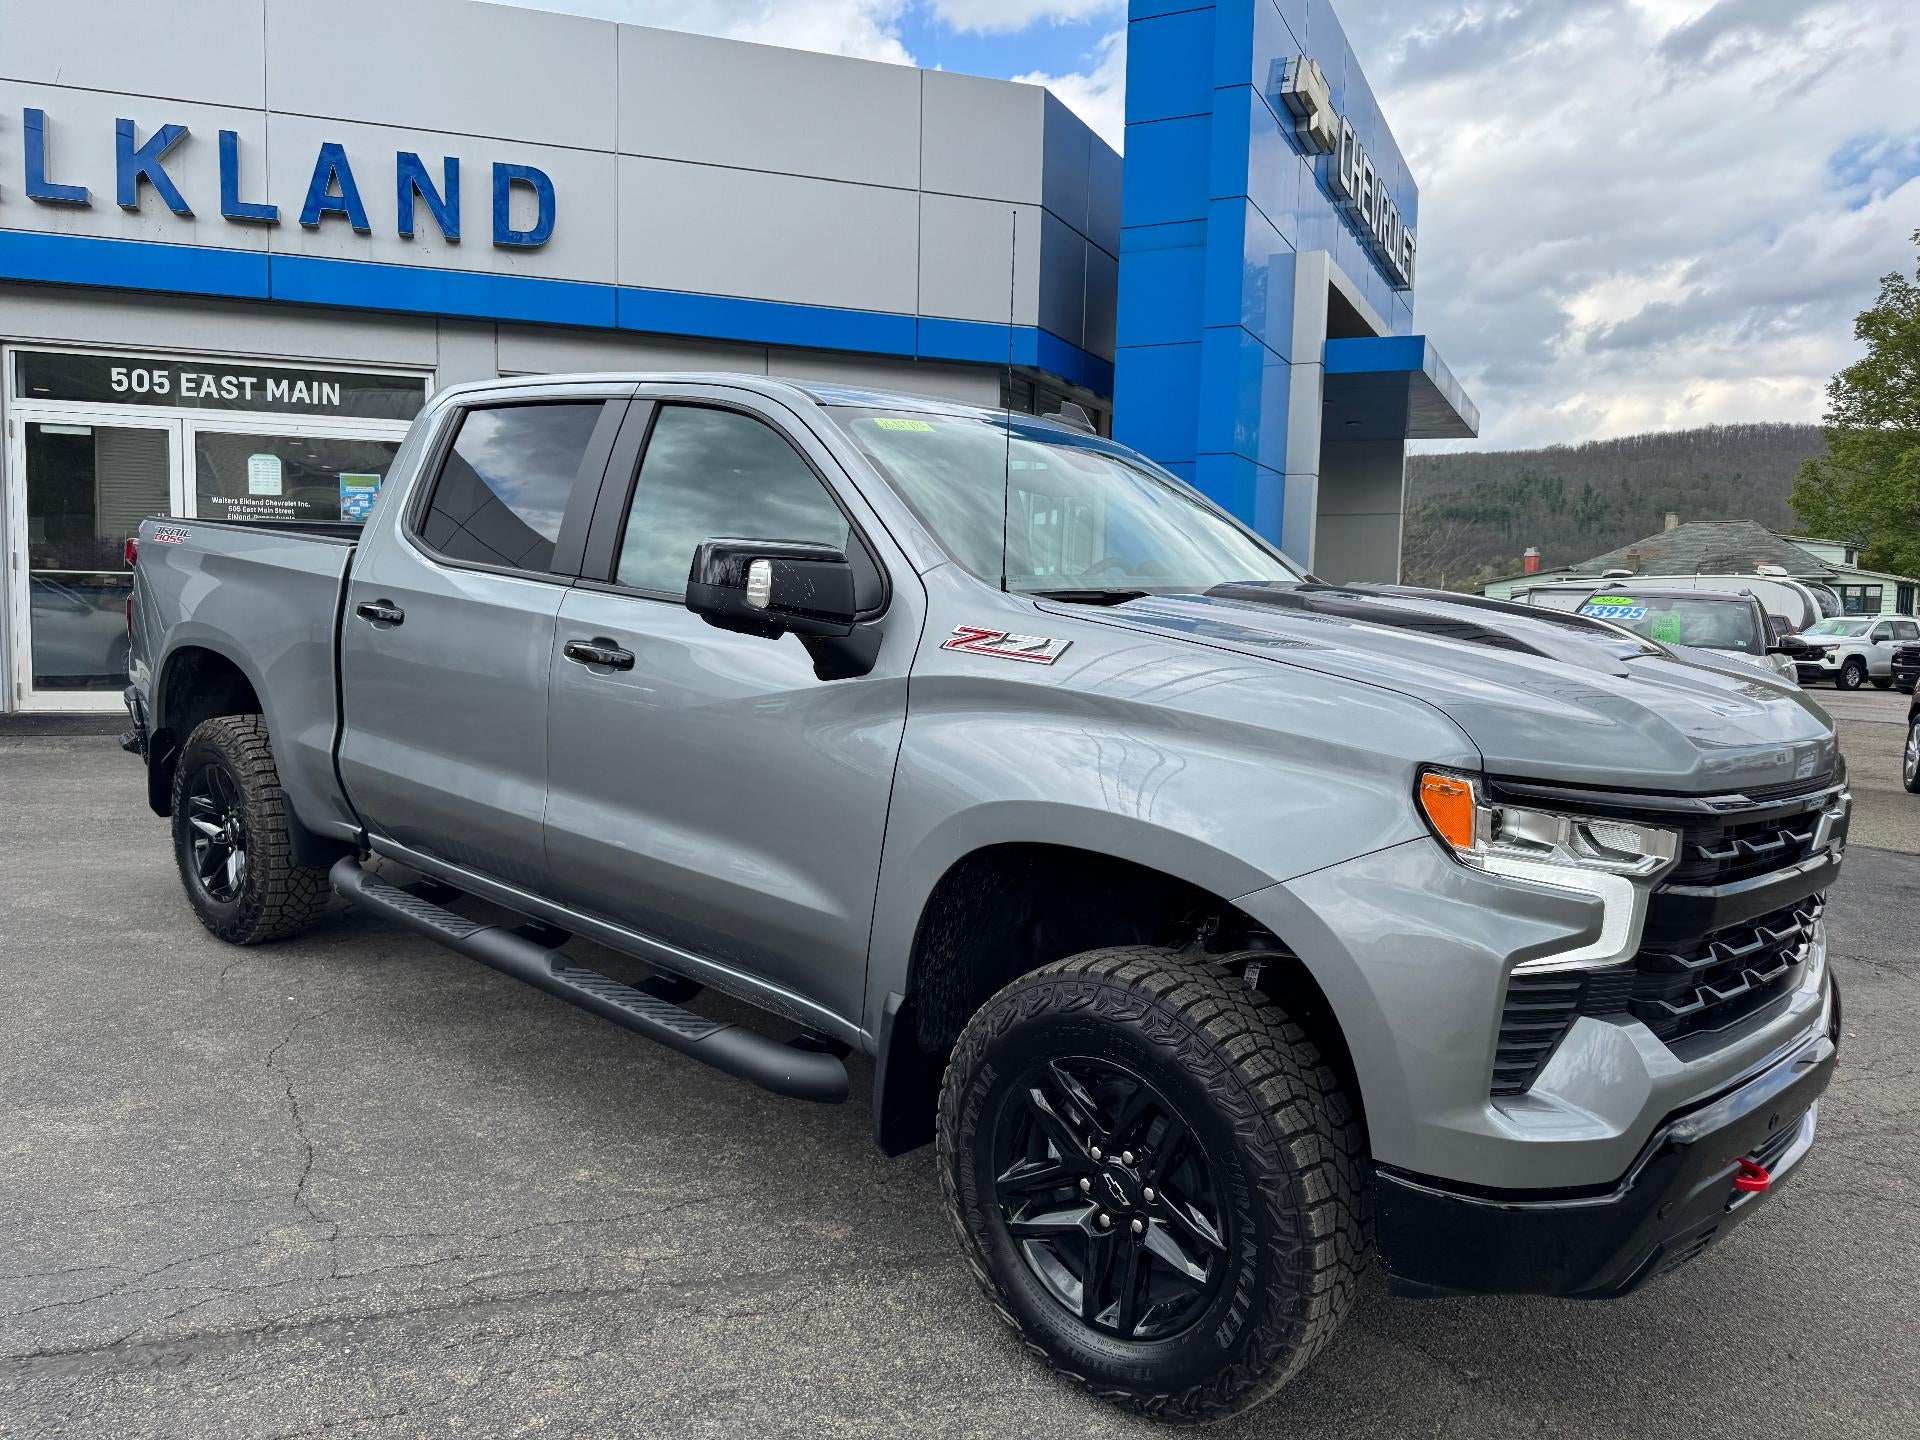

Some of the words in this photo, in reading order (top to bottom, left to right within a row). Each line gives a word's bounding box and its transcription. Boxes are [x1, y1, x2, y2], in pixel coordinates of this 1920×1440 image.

[0, 106, 557, 249] LKLAND
[1336, 114, 1416, 292] CHEVROLET
[111, 367, 171, 394] 505
[180, 372, 257, 400] EAST
[266, 379, 341, 406] MAIN
[211, 496, 239, 505] Walters
[239, 497, 264, 506] Elkland
[265, 499, 297, 507] Chevrolet
[298, 500, 311, 508] Inc.
[274, 507, 295, 515] Street
[153, 534, 184, 545] BOSS
[156, 526, 192, 538] TRAIL
[1583, 605, 1646, 619] 23995
[940, 623, 1074, 666] Z71
[1216, 1151, 1259, 1349] WRANGLER
